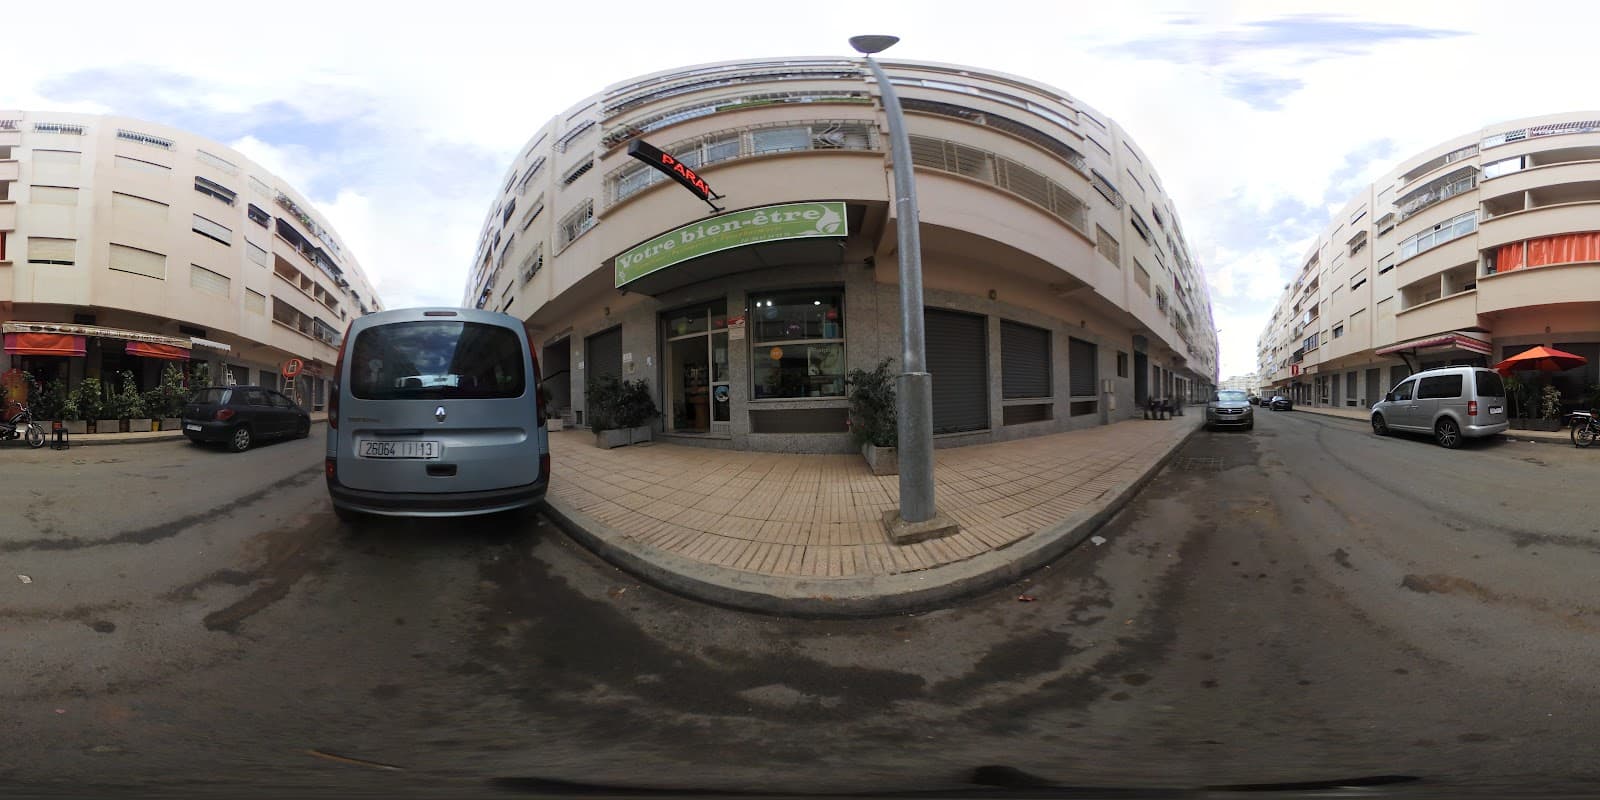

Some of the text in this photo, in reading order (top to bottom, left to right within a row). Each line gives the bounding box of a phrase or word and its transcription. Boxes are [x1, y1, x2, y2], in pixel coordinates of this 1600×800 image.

[617, 235, 676, 270] Votre
[681, 207, 821, 245] bien-être
[421, 442, 432, 457] 13
